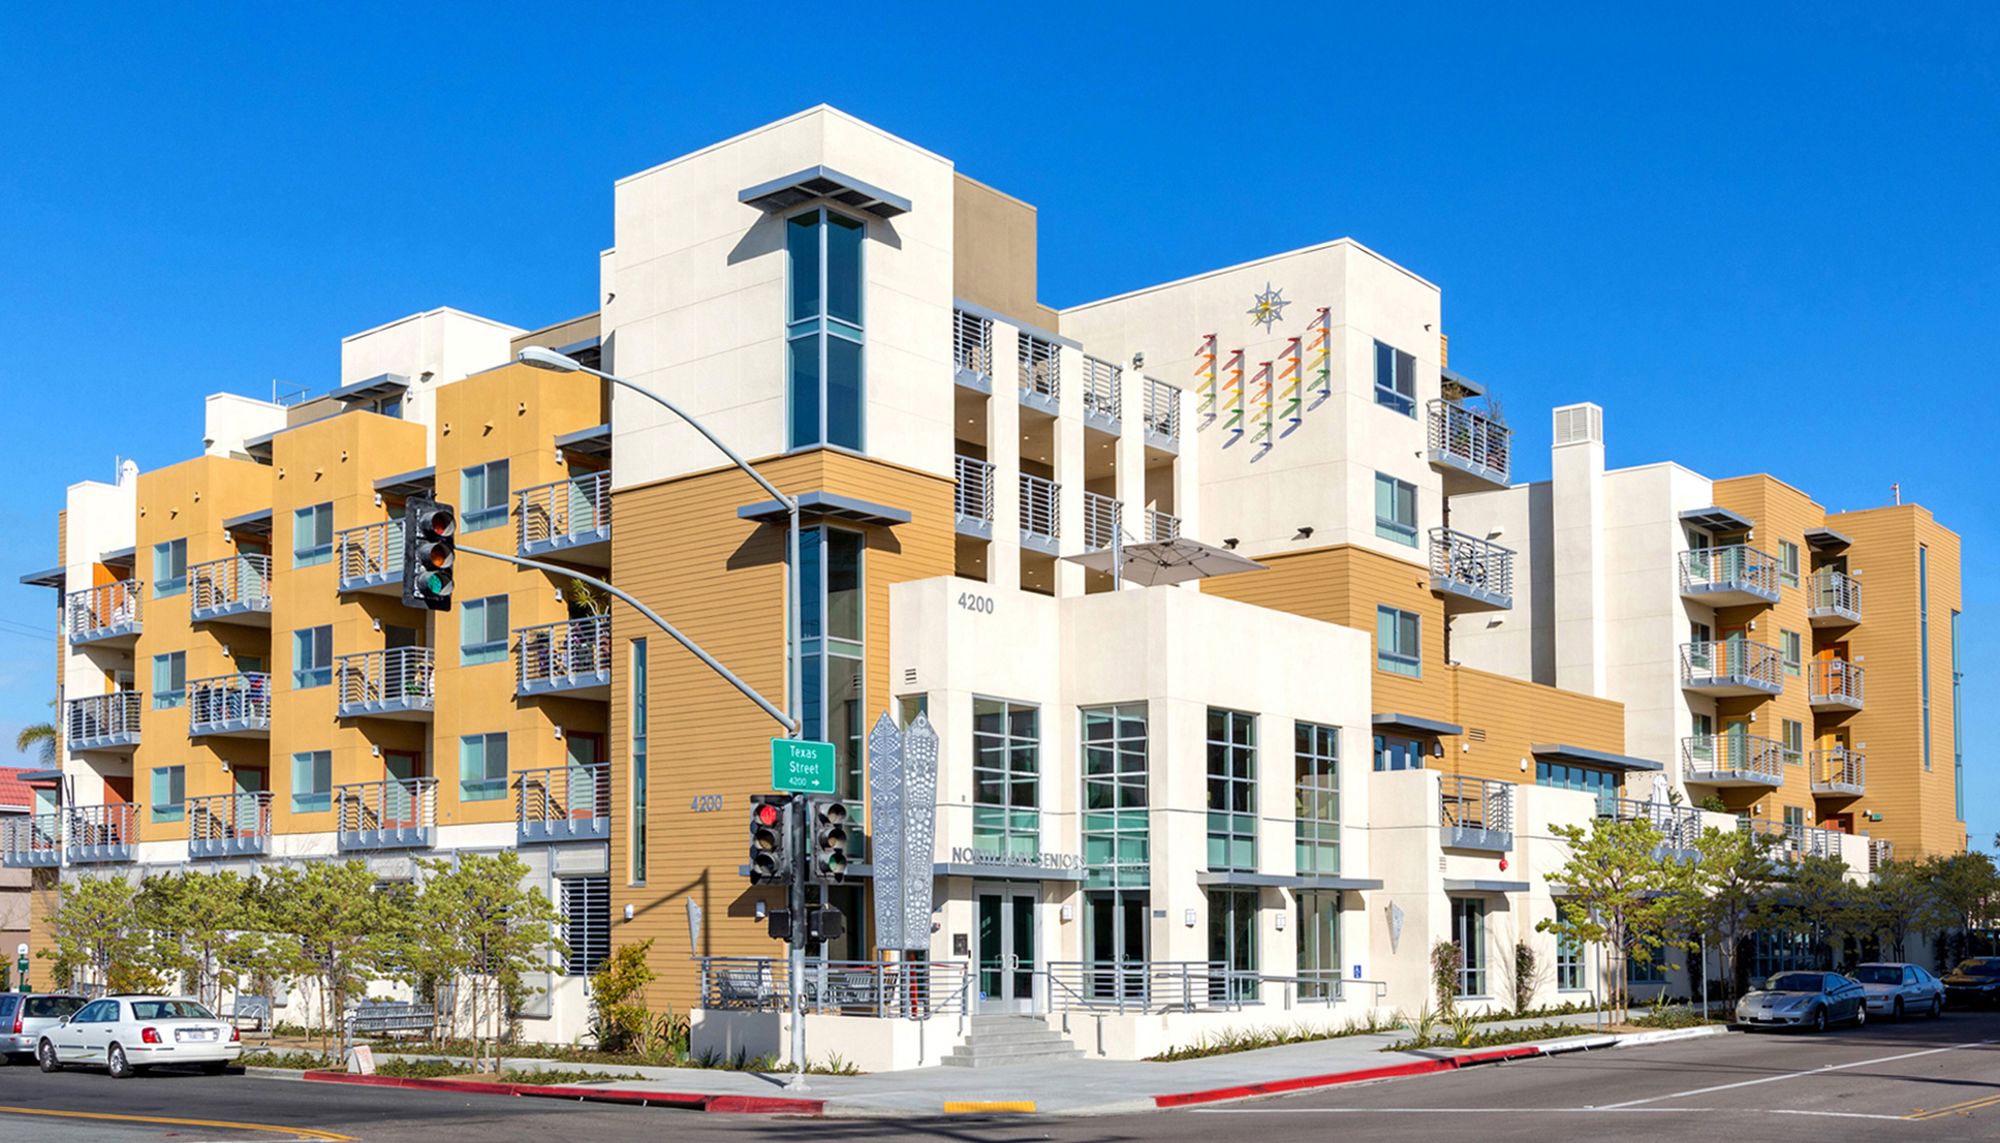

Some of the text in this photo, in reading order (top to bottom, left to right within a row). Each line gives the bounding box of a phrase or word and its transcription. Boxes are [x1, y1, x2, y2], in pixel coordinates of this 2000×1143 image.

[958, 591, 994, 615] 4200
[789, 745, 817, 759] Texas
[789, 760, 819, 774] Street
[789, 776, 807, 786] 4200
[690, 794, 723, 812] 4200
